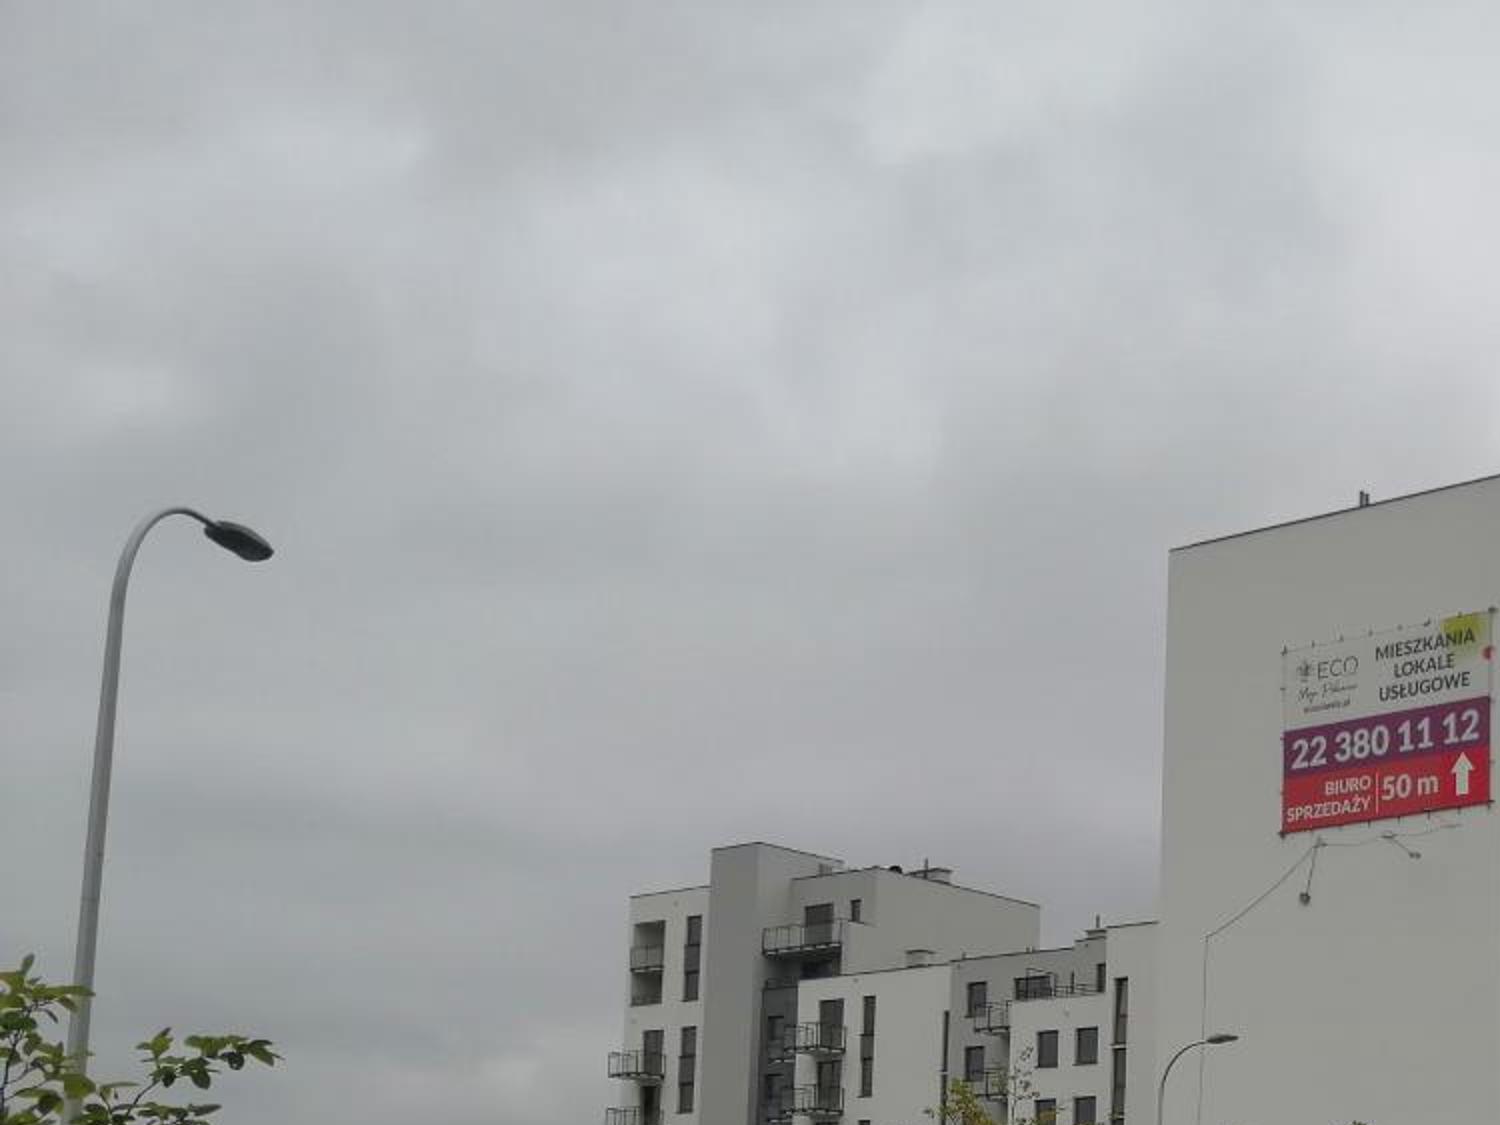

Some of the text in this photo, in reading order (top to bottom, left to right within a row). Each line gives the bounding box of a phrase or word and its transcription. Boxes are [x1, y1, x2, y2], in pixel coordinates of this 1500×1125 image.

[1375, 627, 1476, 661] MIESZKANIA
[1317, 655, 1359, 680] ECO
[1393, 653, 1455, 679] LOKALE
[1379, 671, 1471, 702] USŁUGOWE
[1291, 708, 1480, 770] 22 380 11 12
[1324, 775, 1371, 796] BIURO
[1381, 773, 1439, 801] 50 m
[1286, 796, 1371, 823] SPRZEDAŻY
